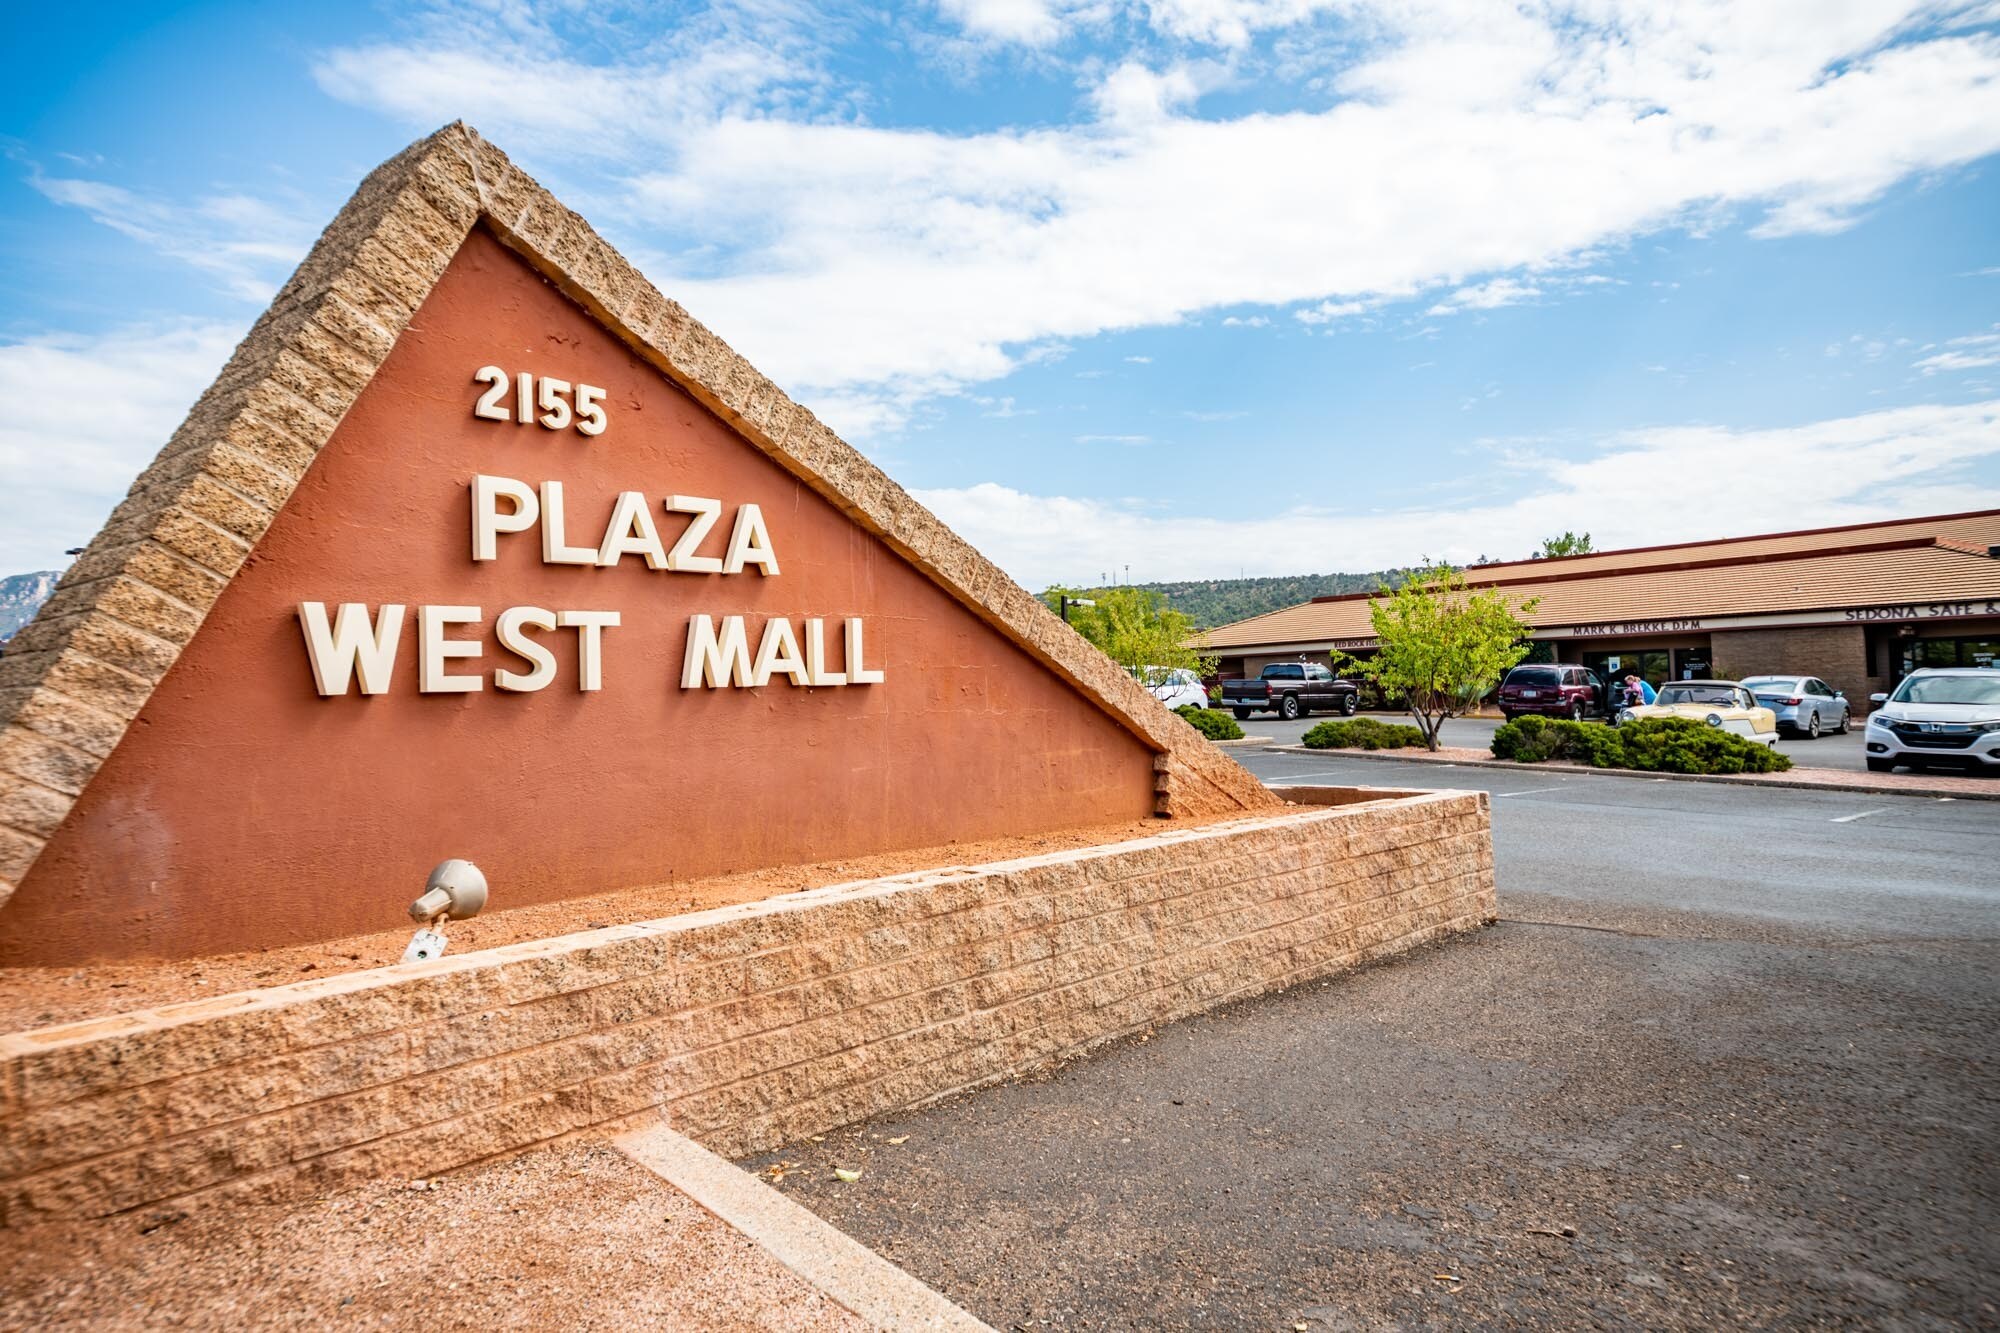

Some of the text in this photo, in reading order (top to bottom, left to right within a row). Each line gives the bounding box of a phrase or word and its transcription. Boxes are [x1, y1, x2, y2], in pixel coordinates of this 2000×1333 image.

[474, 365, 607, 436] 2155
[471, 474, 780, 576] PLAZA
[1573, 625, 1605, 636] MARK
[1845, 602, 2000, 621] SEDONA SAFE &
[298, 601, 885, 696] WEST MALL
